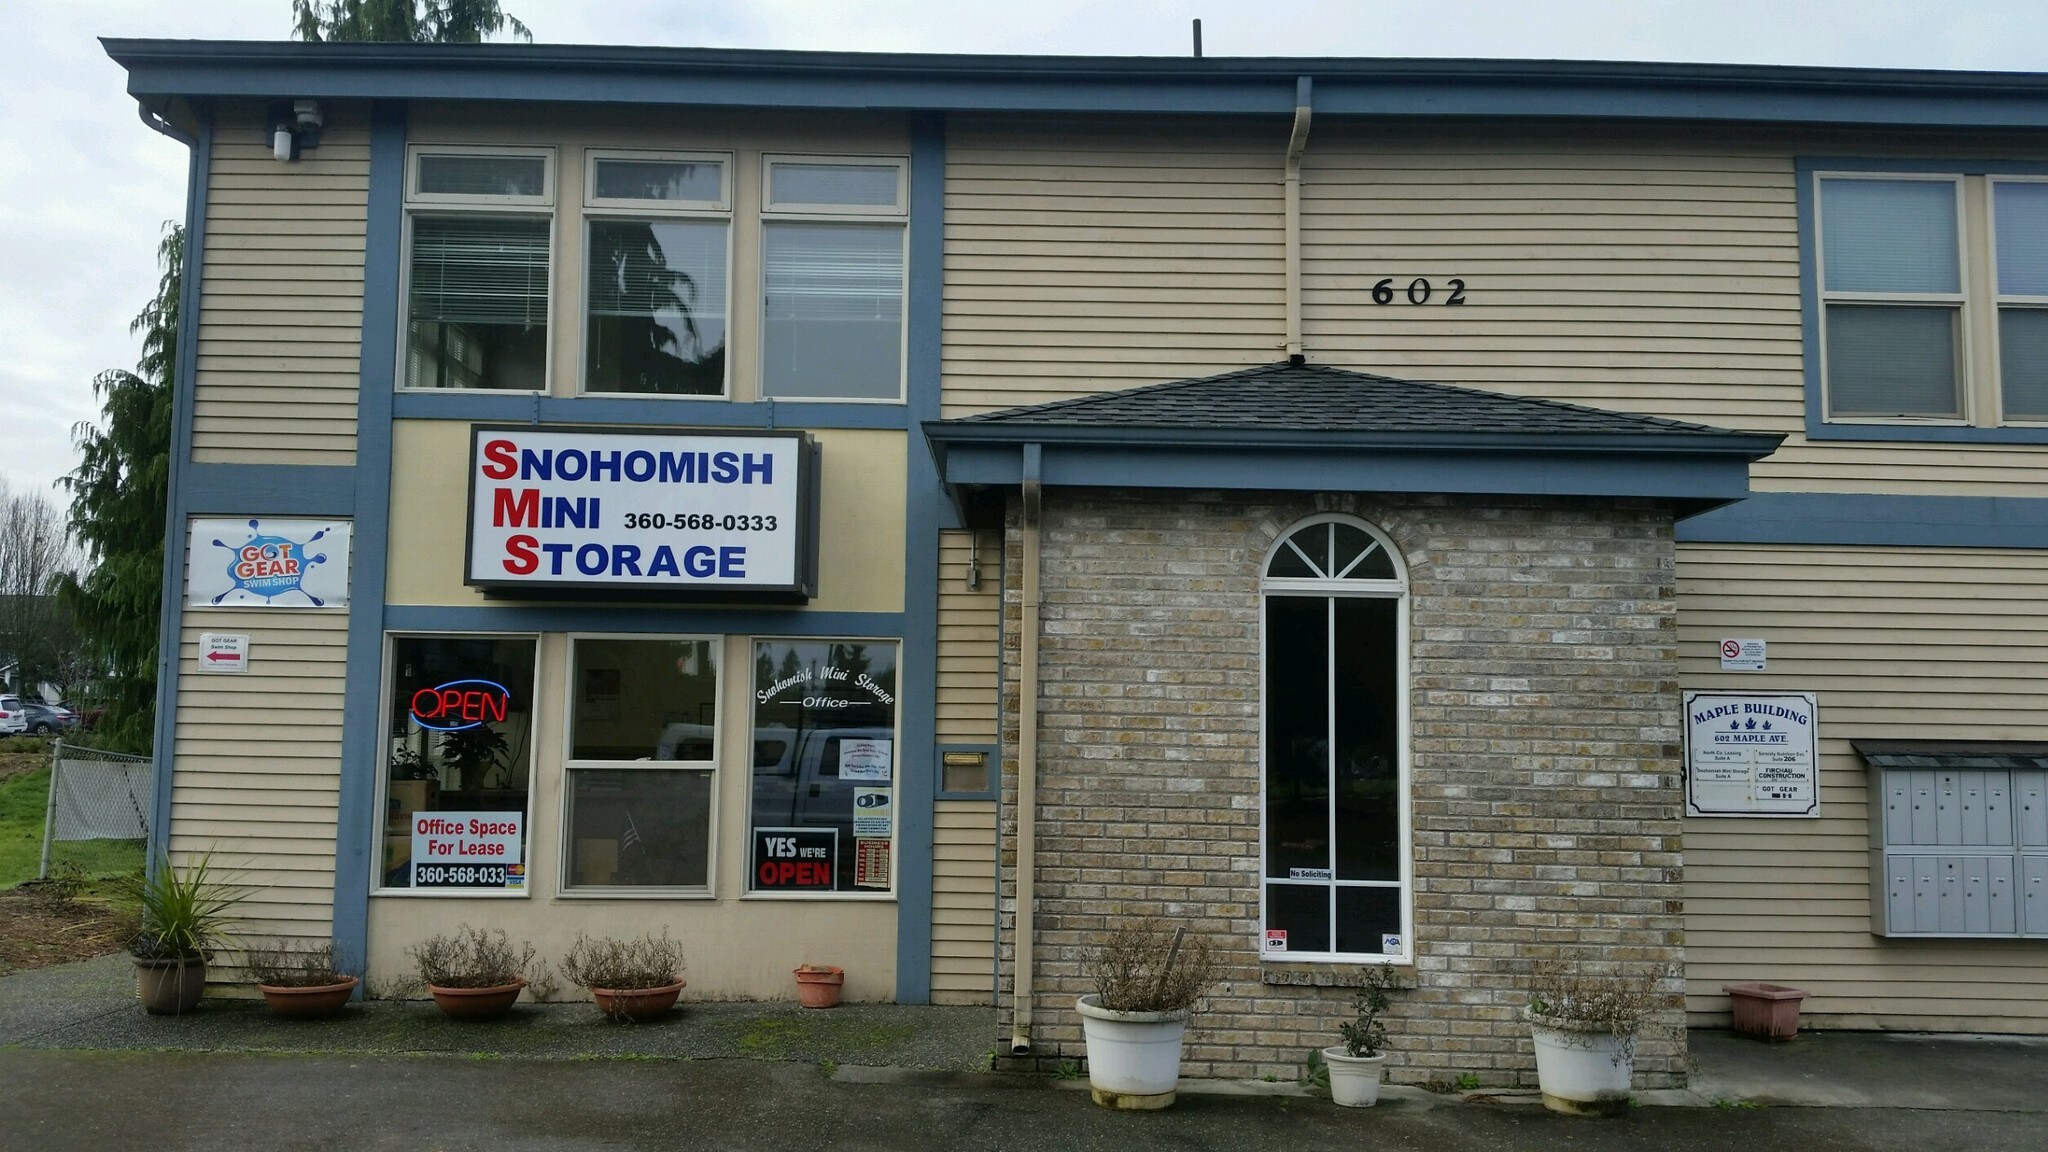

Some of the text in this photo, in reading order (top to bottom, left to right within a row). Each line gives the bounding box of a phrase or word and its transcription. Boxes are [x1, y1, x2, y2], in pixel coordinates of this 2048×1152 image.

[1372, 277, 1466, 305] 602
[482, 439, 774, 485] SNOHOMISH
[493, 487, 600, 529] MINI
[624, 512, 778, 532] 360-568-0333
[241, 543, 292, 562] GOT
[502, 534, 747, 579] STORAGE
[236, 559, 300, 578] GEAR
[243, 576, 300, 589] SWIM SHOP
[756, 665, 894, 705] Snohomish Mini Storage
[411, 688, 507, 723] OPEN
[802, 696, 848, 708] Office
[1693, 703, 1808, 726] MAPLE BUILDING
[1714, 734, 1789, 743] 602 MAPLE AVE.
[416, 818, 517, 839] Office Space
[428, 839, 505, 856] For Lease
[764, 837, 826, 858] YES WE'RE
[759, 861, 831, 886] OPEN
[1290, 869, 1332, 879] No Soliciting
